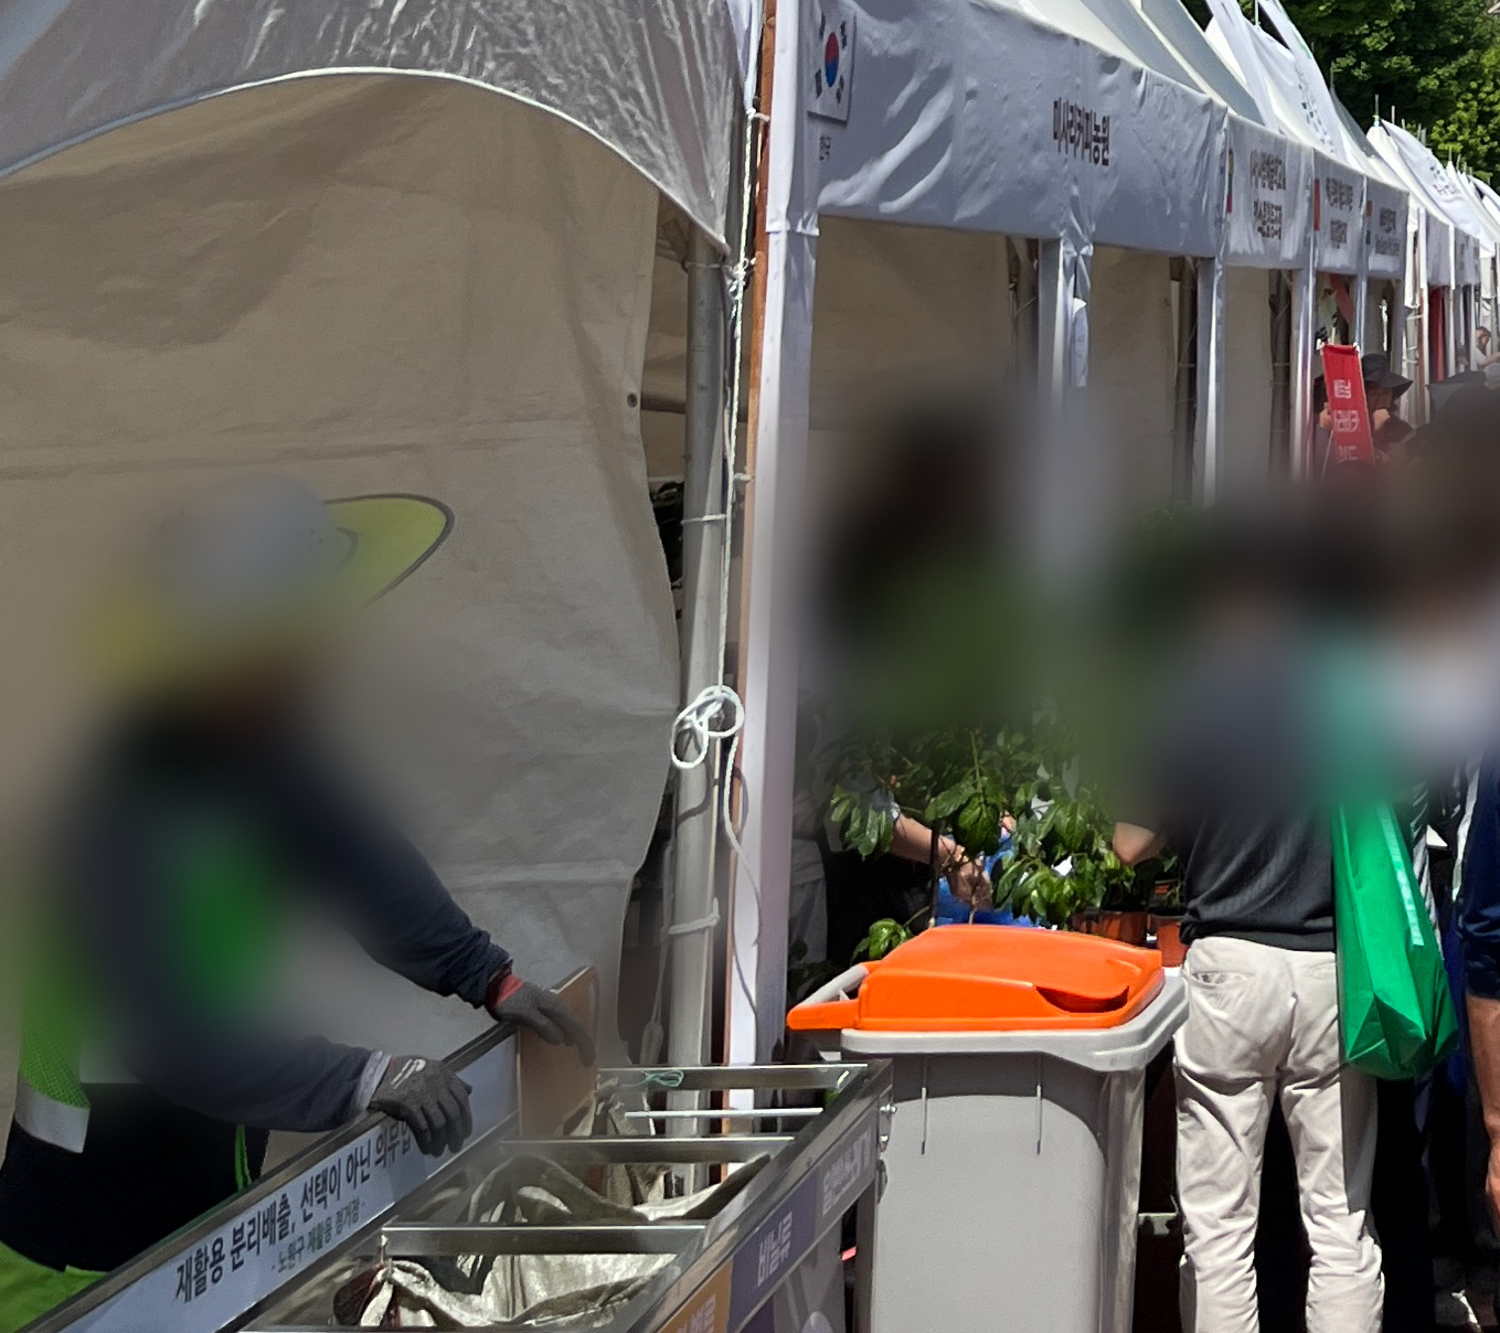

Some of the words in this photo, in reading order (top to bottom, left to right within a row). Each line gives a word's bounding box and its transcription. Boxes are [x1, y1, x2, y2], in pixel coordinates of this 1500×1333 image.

[176, 1238, 224, 1302] 재활용
[230, 1194, 295, 1271] 분리배출,
[300, 1158, 341, 1223] 선택이
[346, 1140, 371, 1187] 아닌
[277, 1238, 305, 1274] 노원구
[307, 1220, 332, 1252] 재활용
[757, 1211, 793, 1288] 비닐류
